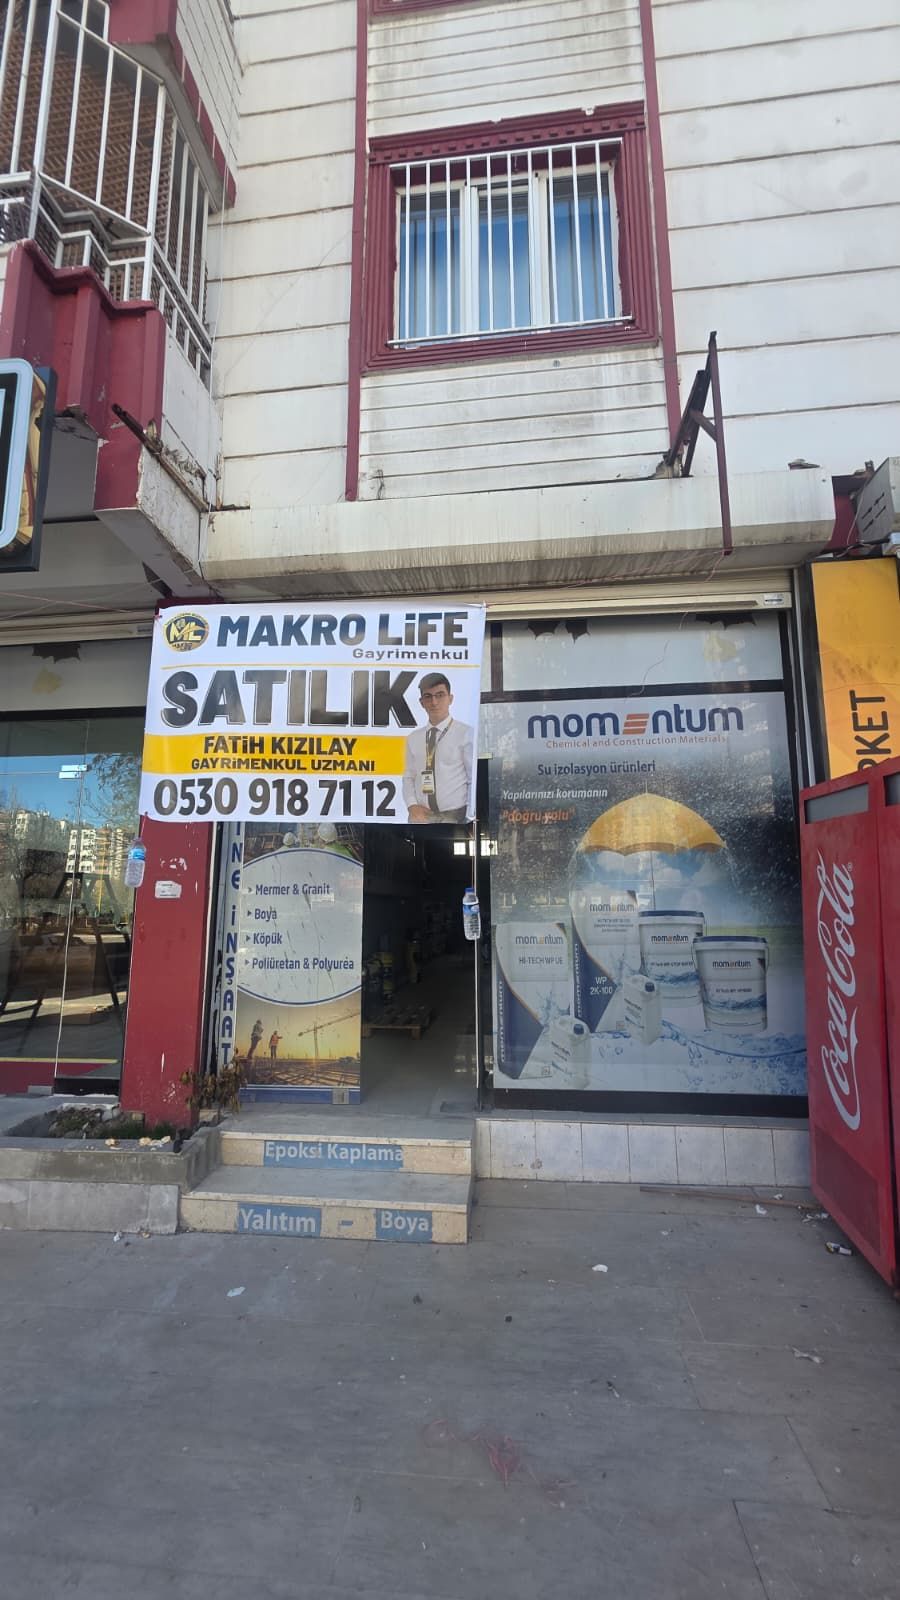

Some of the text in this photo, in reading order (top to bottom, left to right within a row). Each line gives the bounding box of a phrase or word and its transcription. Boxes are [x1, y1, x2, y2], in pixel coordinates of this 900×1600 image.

[217, 613, 366, 647] MAKRO
[352, 648, 469, 662] Gayrimenkul
[161, 670, 418, 729] SATILIK
[271, 736, 357, 756] KIZILAY
[546, 734, 727, 749] Chemical and Construction Materials
[310, 759, 375, 772] UZMANI
[537, 760, 656, 779] Su izolasyon ürünleri
[154, 777, 239, 816] 0530
[248, 778, 309, 816] 918
[556, 788, 608, 799] korumanın
[255, 883, 331, 896] Mermer & Granit
[254, 908, 277, 921] Boya
[253, 932, 283, 946] Köpük
[252, 957, 354, 972] Poliüretan & Polyurea
[816, 847, 860, 1131] Coca-Cola
[265, 1142, 403, 1164] Epoksi Kaplama
[239, 1208, 316, 1233] Yalıtım
[381, 1211, 430, 1235] Boya
